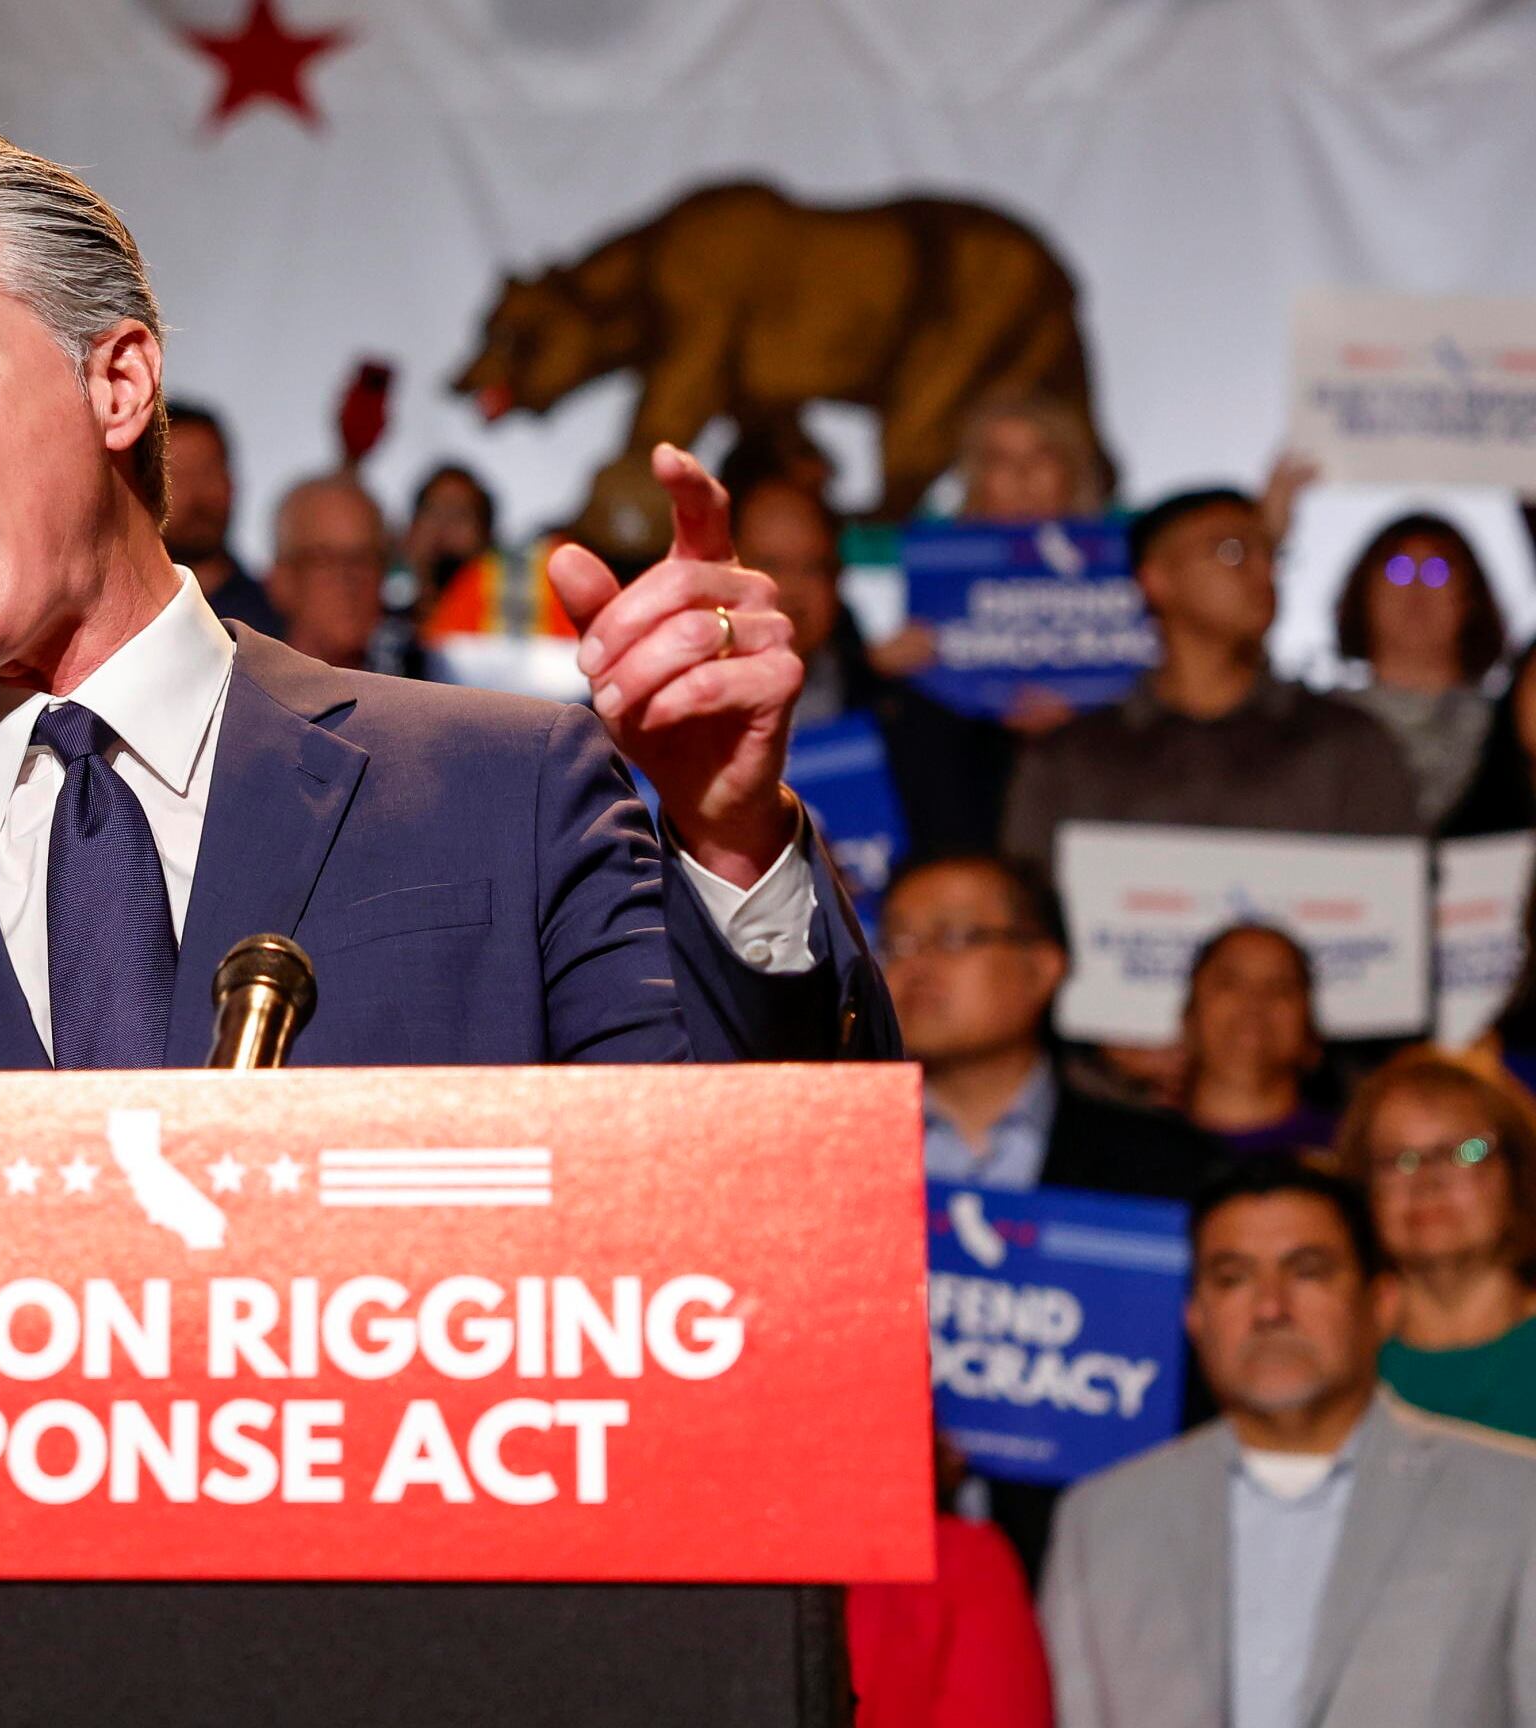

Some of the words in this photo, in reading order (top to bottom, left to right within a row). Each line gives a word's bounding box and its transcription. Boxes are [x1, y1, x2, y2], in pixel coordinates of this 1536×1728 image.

[207, 1274, 744, 1380] RIGGING
[930, 1272, 1083, 1347] FEND
[931, 1338, 1158, 1418] CRACY
[372, 1398, 629, 1505] ACT
